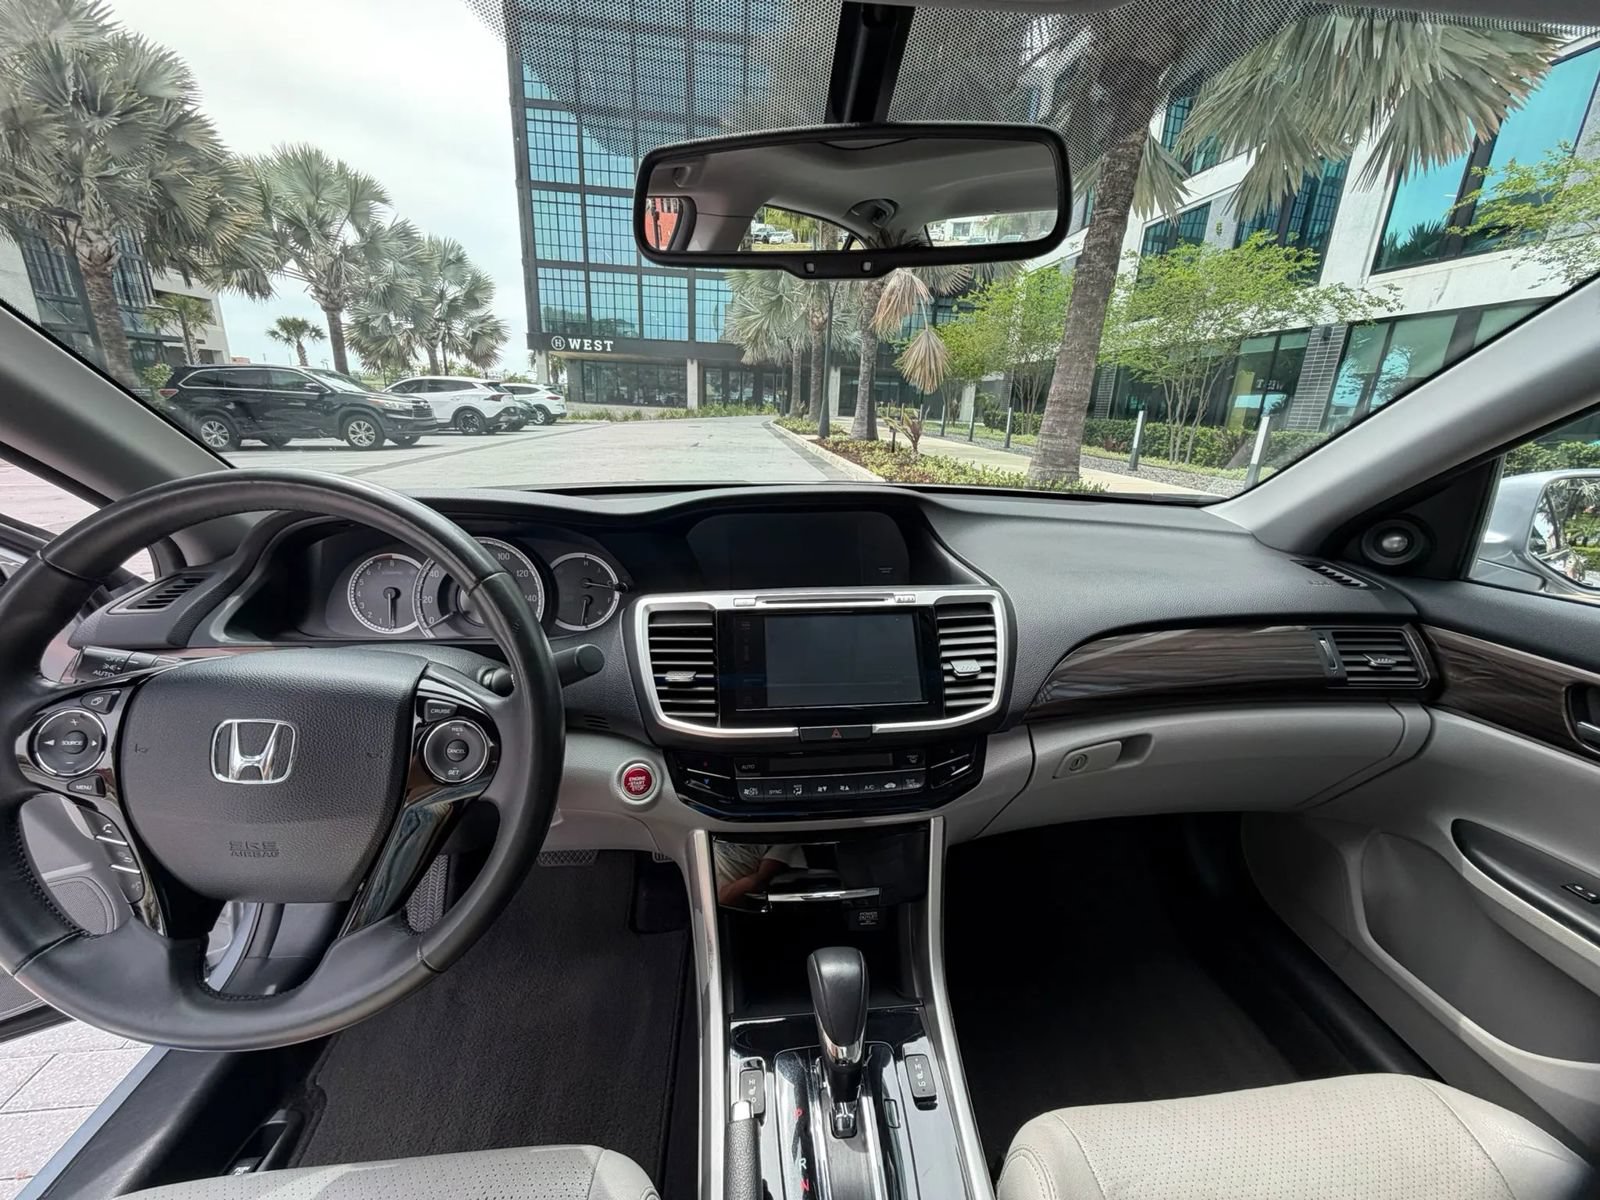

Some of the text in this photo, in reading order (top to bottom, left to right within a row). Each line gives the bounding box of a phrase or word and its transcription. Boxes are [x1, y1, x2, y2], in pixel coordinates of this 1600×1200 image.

[568, 338, 614, 351] WEST
[497, 552, 510, 560] 100
[429, 570, 440, 578] 40
[516, 569, 529, 578] 120
[422, 596, 433, 604] 20
[428, 616, 435, 624] 0
[92, 670, 115, 678] AUTO
[793, 1107, 803, 1118] P
[799, 1157, 807, 1170] R
[799, 1178, 810, 1191] N
